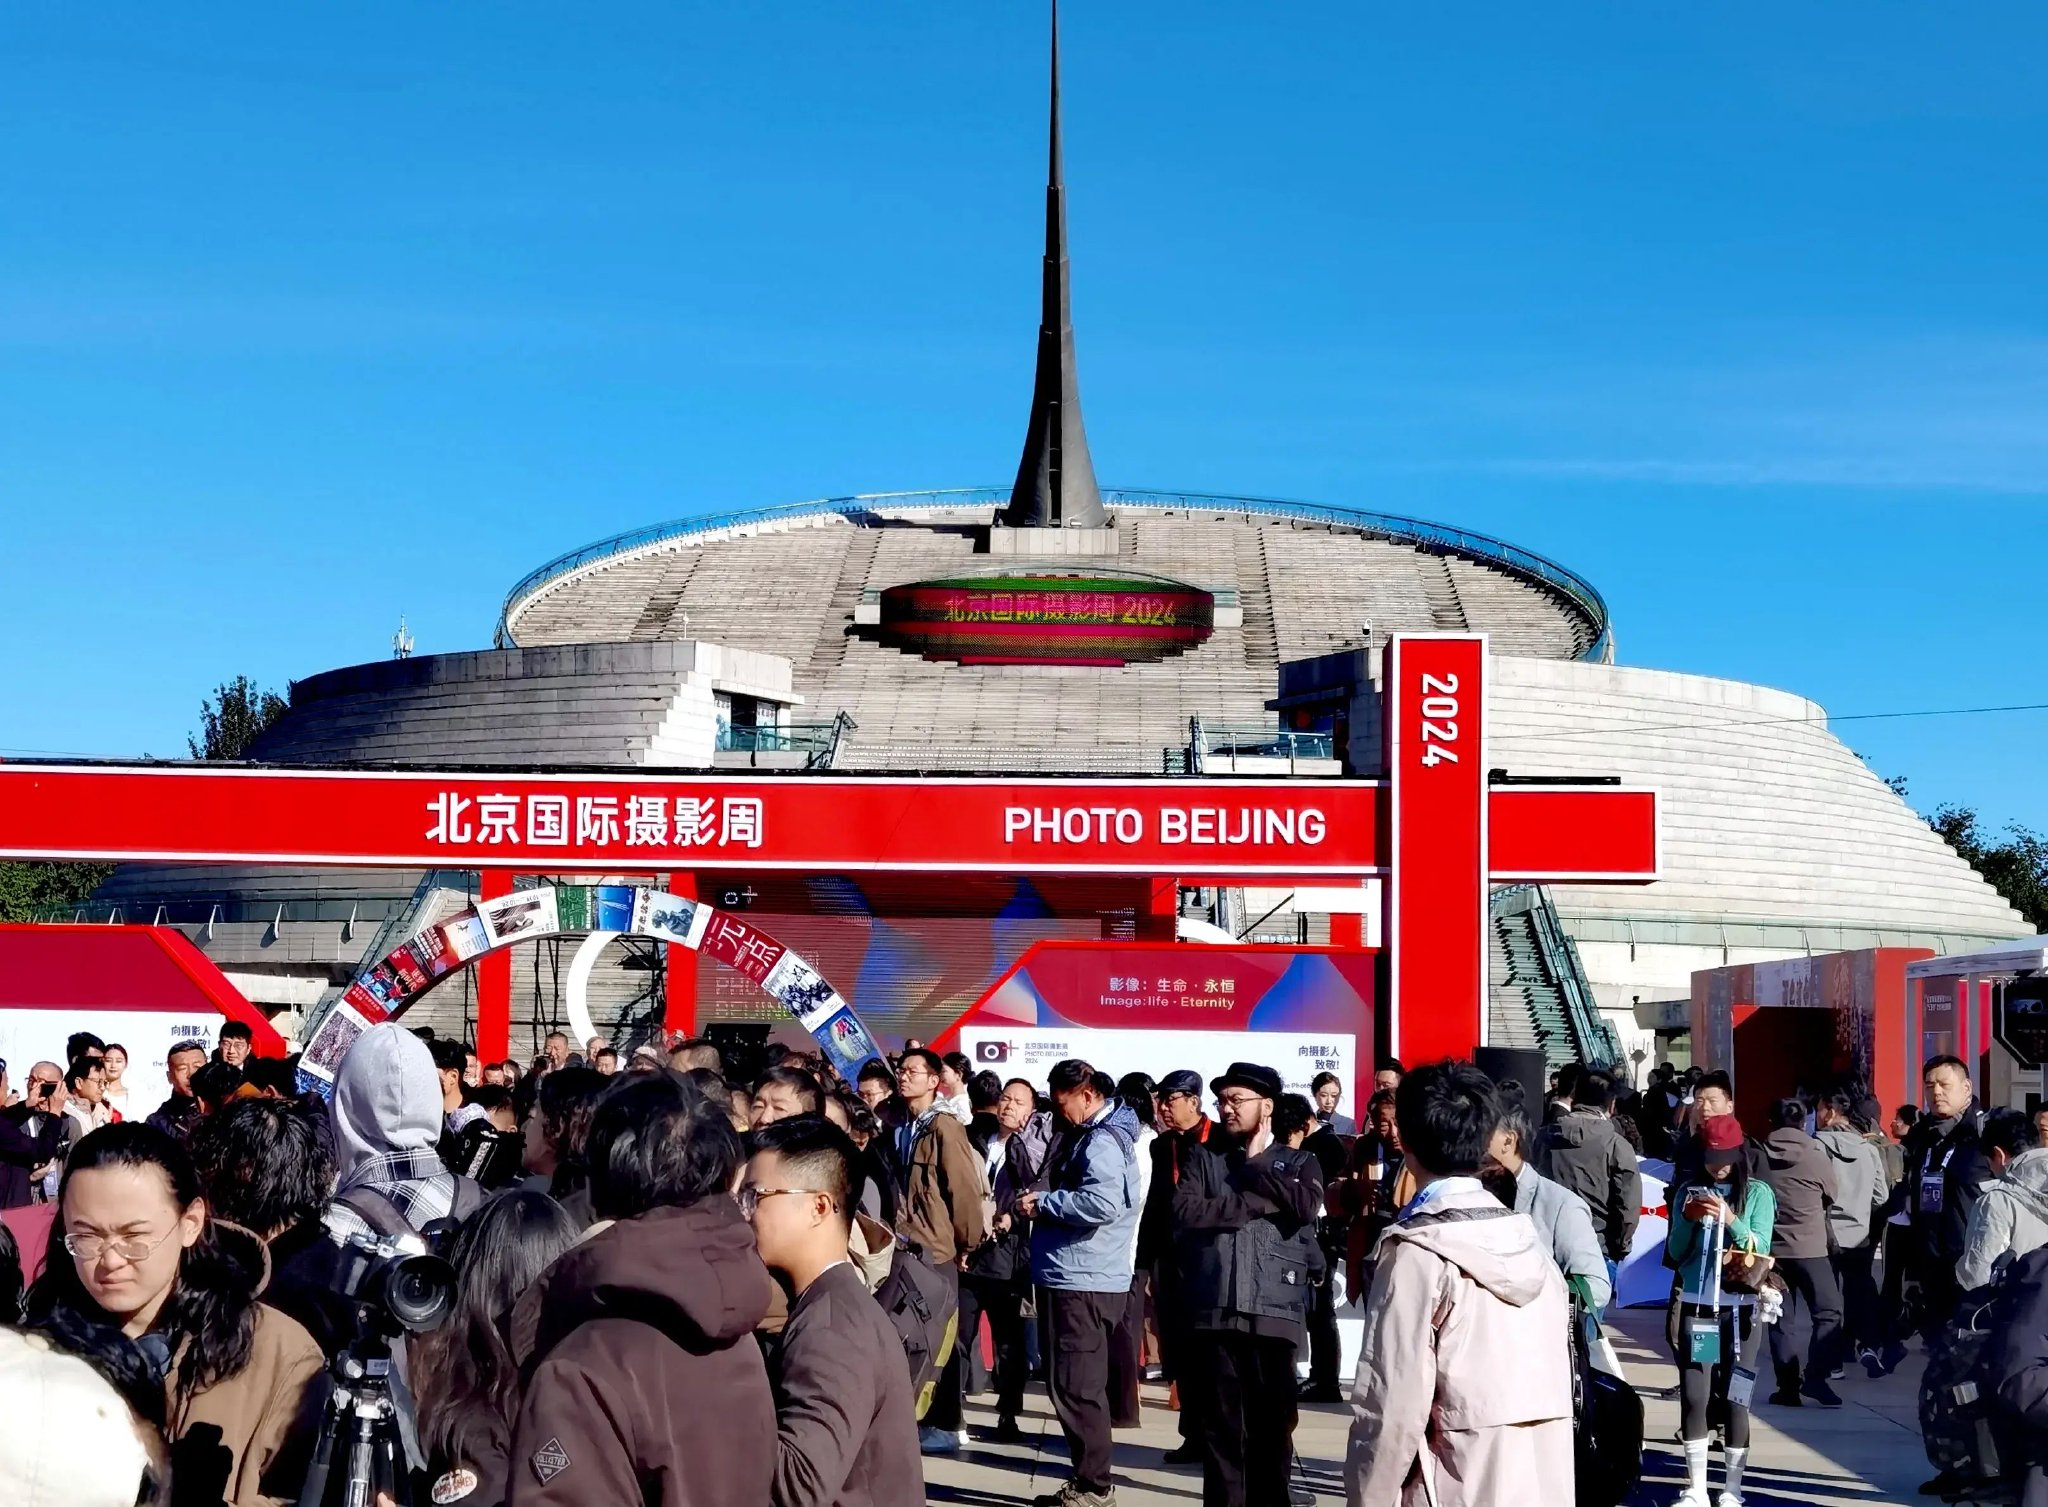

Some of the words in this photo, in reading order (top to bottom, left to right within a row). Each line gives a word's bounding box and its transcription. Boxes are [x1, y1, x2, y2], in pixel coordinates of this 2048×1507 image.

[944, 593, 1115, 624] 北京国际摄影周
[1121, 596, 1177, 625] 2024
[1421, 673, 1459, 767] 2024
[425, 792, 763, 848] 北京国际摄影周
[1004, 807, 1143, 844] PHOTO
[1160, 808, 1326, 845] BEIJING
[1181, 996, 1235, 1010] Eternity
[171, 1025, 211, 1036] 向摄影人
[1298, 1045, 1340, 1057] 向摄影人
[1315, 1060, 1340, 1070] 致敬!
